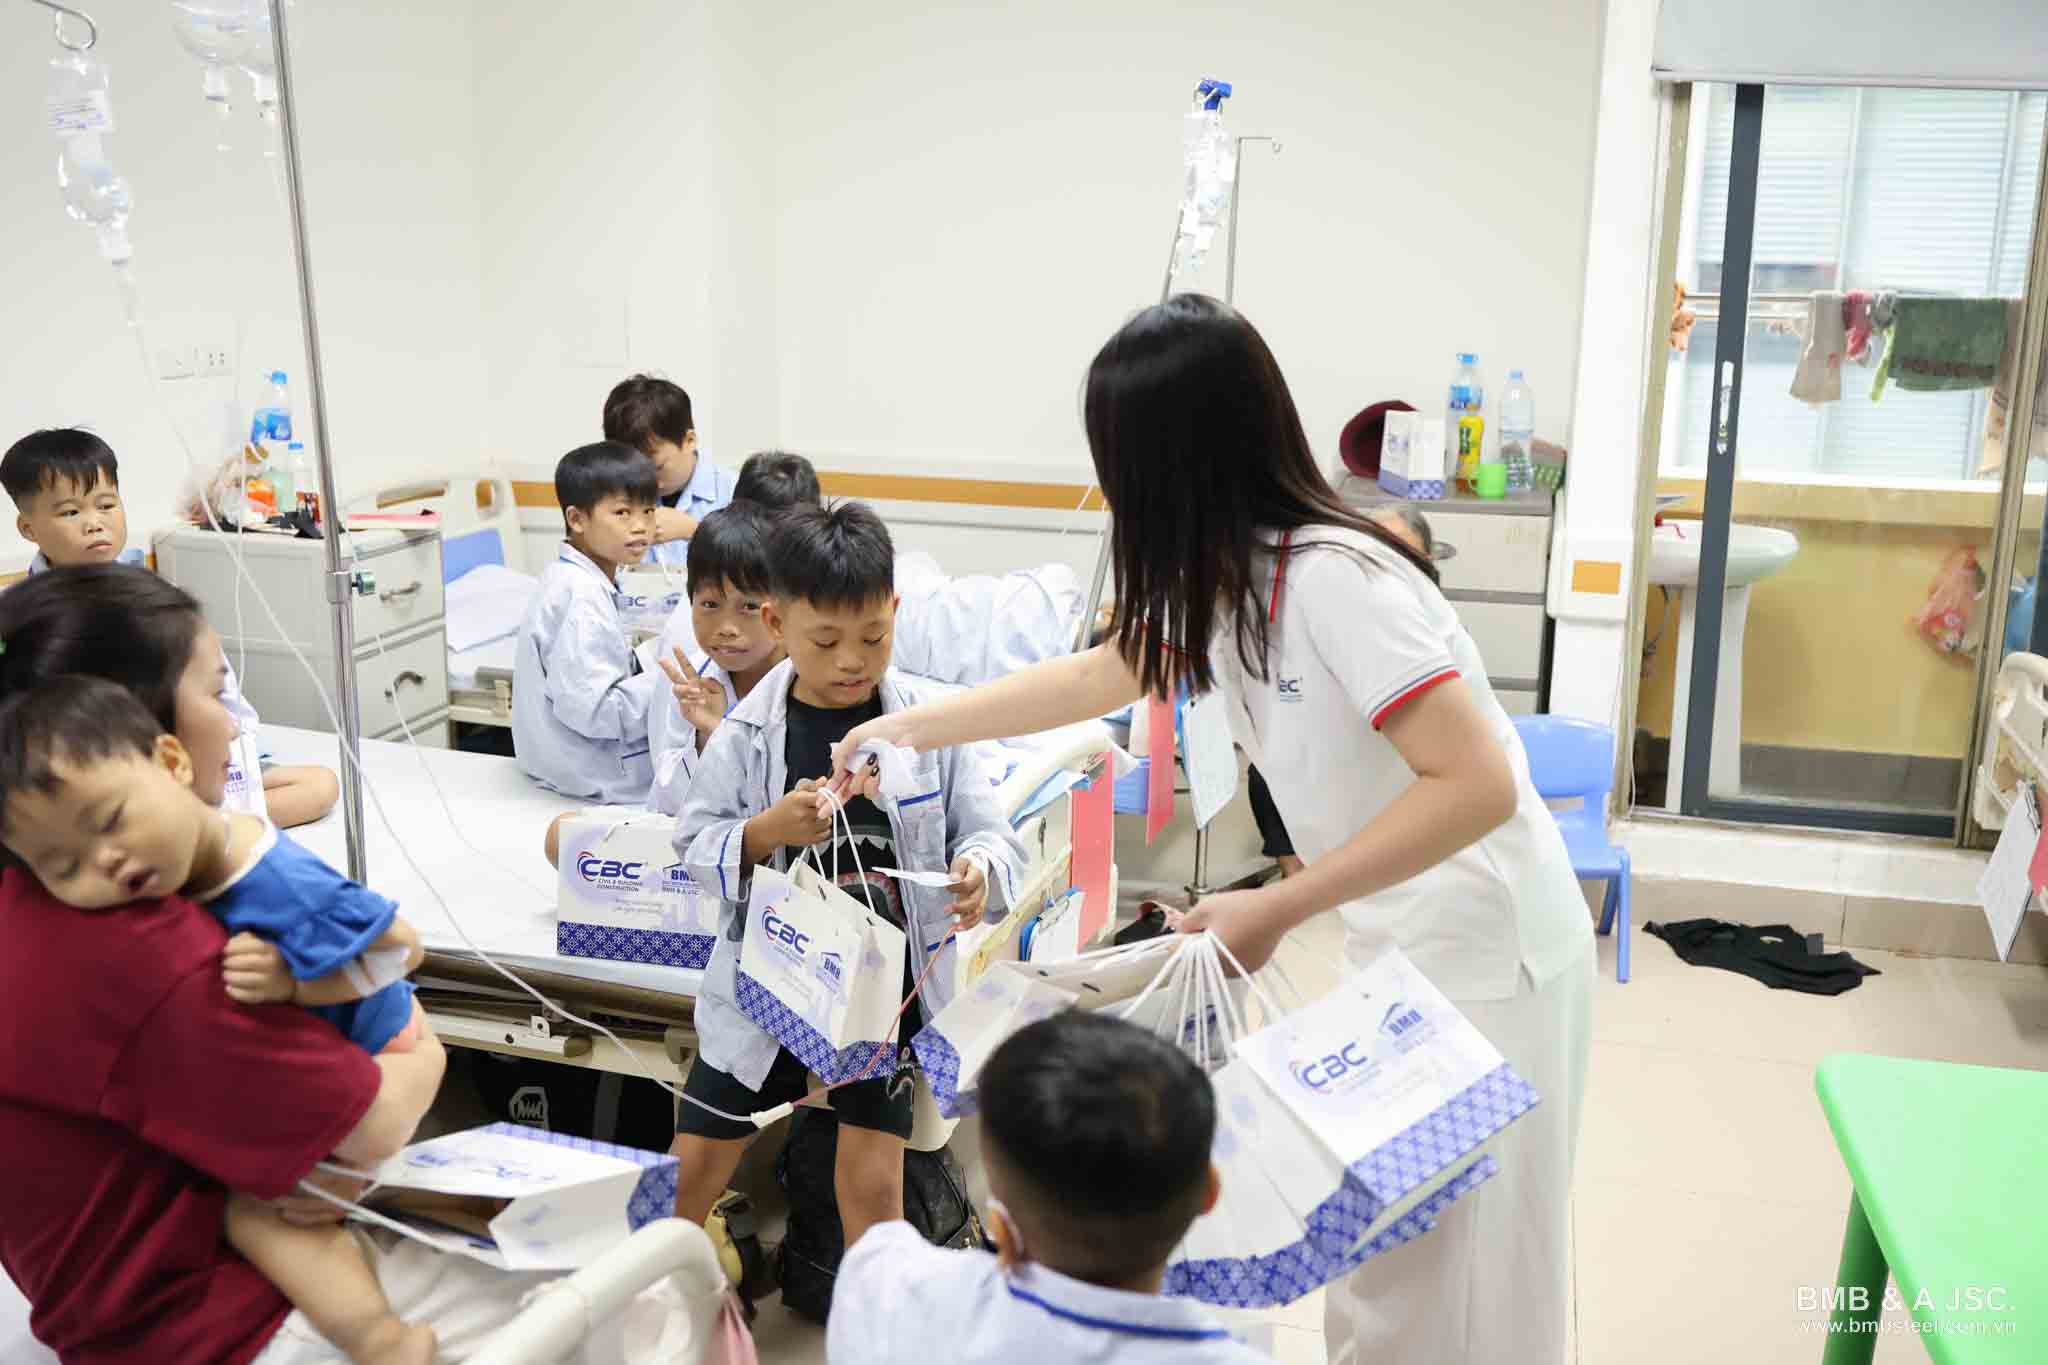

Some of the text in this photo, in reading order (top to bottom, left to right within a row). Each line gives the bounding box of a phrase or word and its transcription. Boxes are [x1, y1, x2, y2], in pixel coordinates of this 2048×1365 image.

[580, 859, 643, 880] CBC
[671, 869, 696, 881] BM
[764, 915, 810, 955] CBC
[1301, 1041, 1369, 1088] CBC
